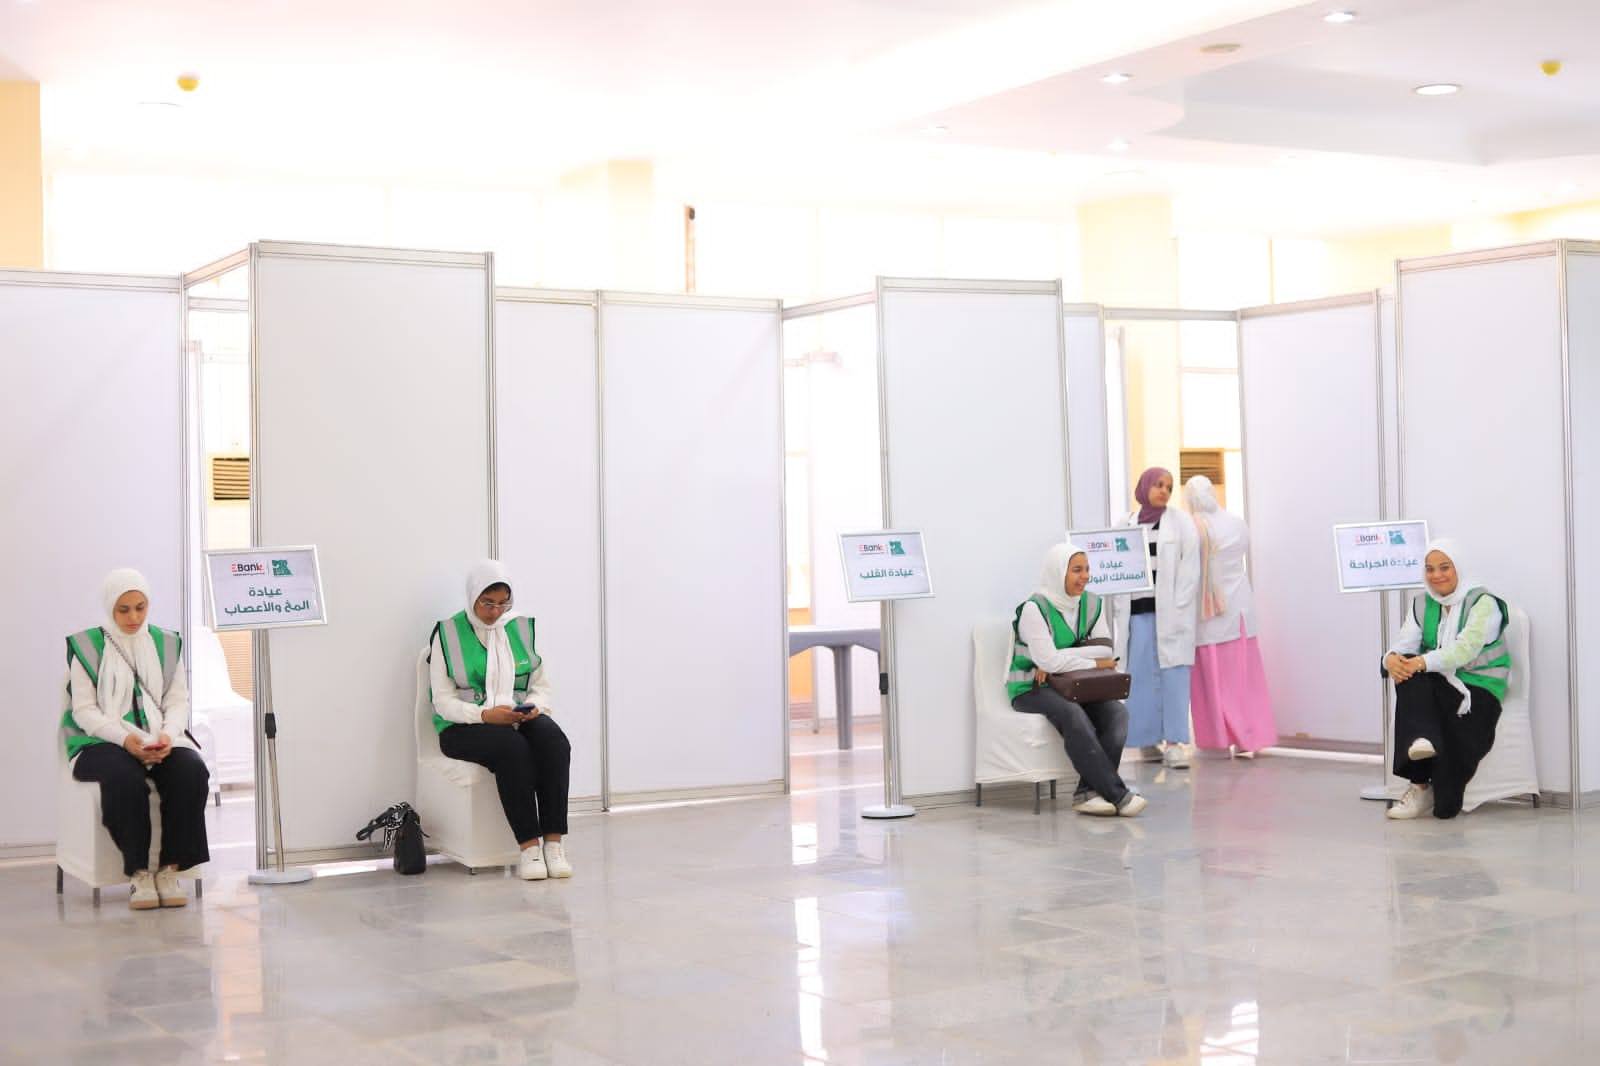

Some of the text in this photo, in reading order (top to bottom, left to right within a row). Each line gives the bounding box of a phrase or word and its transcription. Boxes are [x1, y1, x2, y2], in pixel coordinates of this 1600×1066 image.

[1100, 561, 1123, 570] عيادة
[1349, 560, 1388, 570] الجراحة
[860, 569, 913, 579] عيادة القلب
[1088, 571, 1145, 584] المسالك البول
[249, 586, 282, 598] عيادة
[224, 600, 310, 616] المخ والأعصاب
